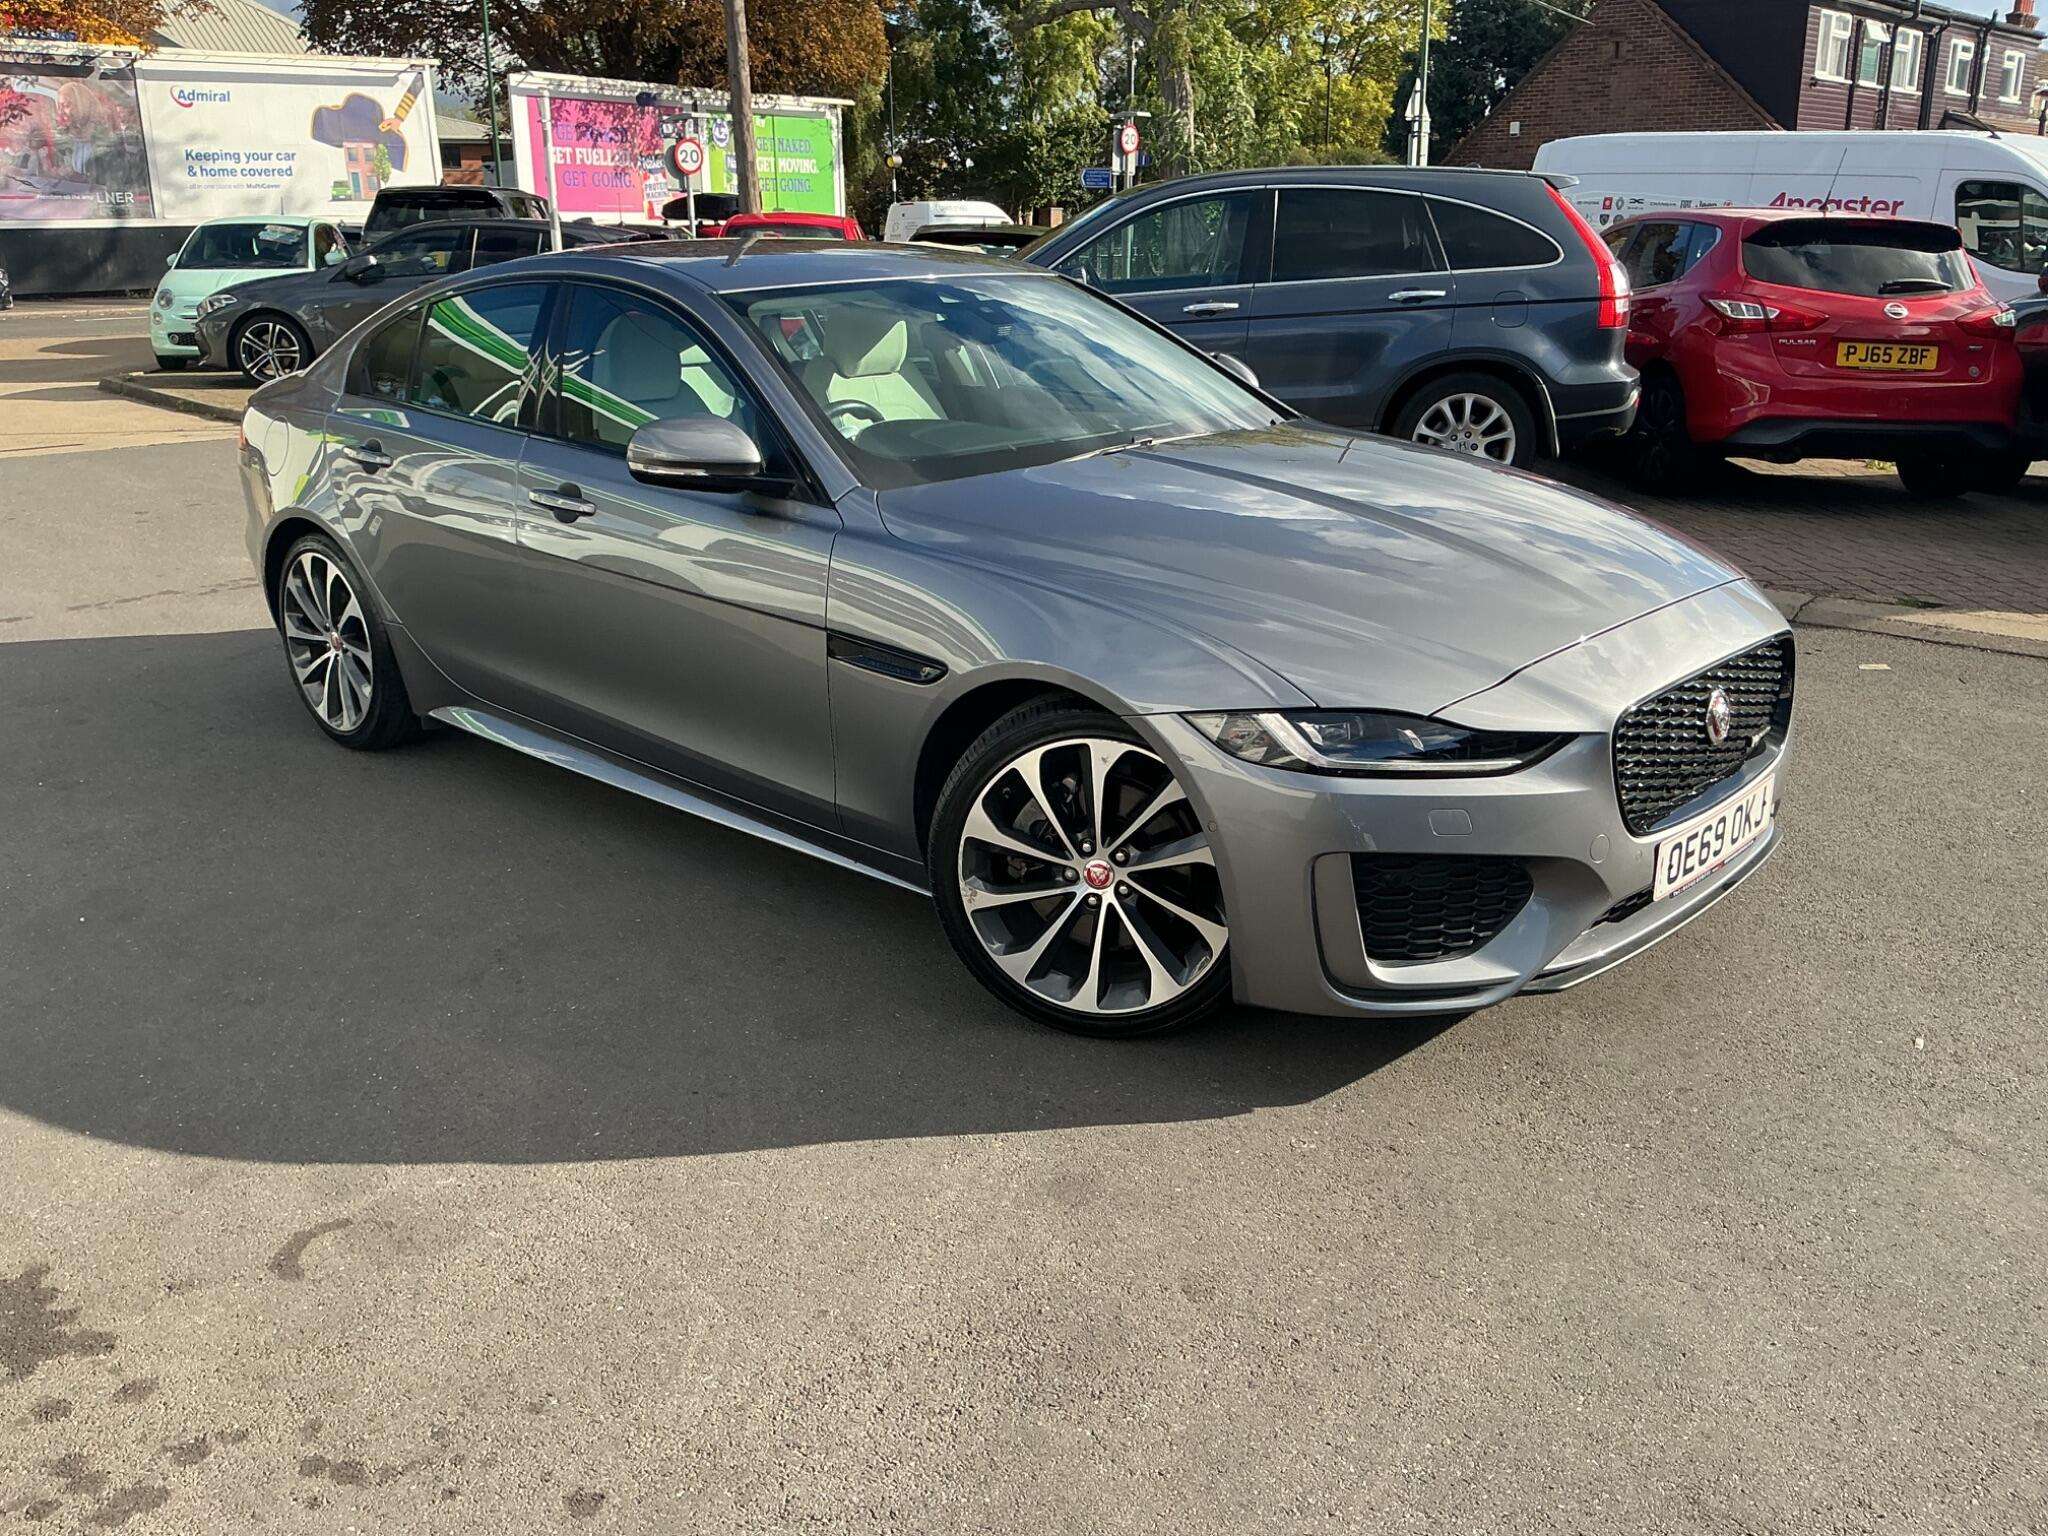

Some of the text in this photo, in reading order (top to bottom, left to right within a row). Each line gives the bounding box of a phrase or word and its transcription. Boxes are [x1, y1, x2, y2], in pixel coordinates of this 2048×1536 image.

[177, 89, 231, 102] Admiral
[1125, 133, 1136, 145] 20
[185, 149, 297, 164] Keeping your car
[680, 149, 699, 163] 20
[187, 165, 293, 177] & home covered
[562, 170, 586, 187] GET
[96, 192, 135, 204] LNER
[1845, 344, 1931, 365] PJ65 ZBF
[1667, 816, 1727, 885] OE69
[1731, 786, 1767, 846] OKJ
